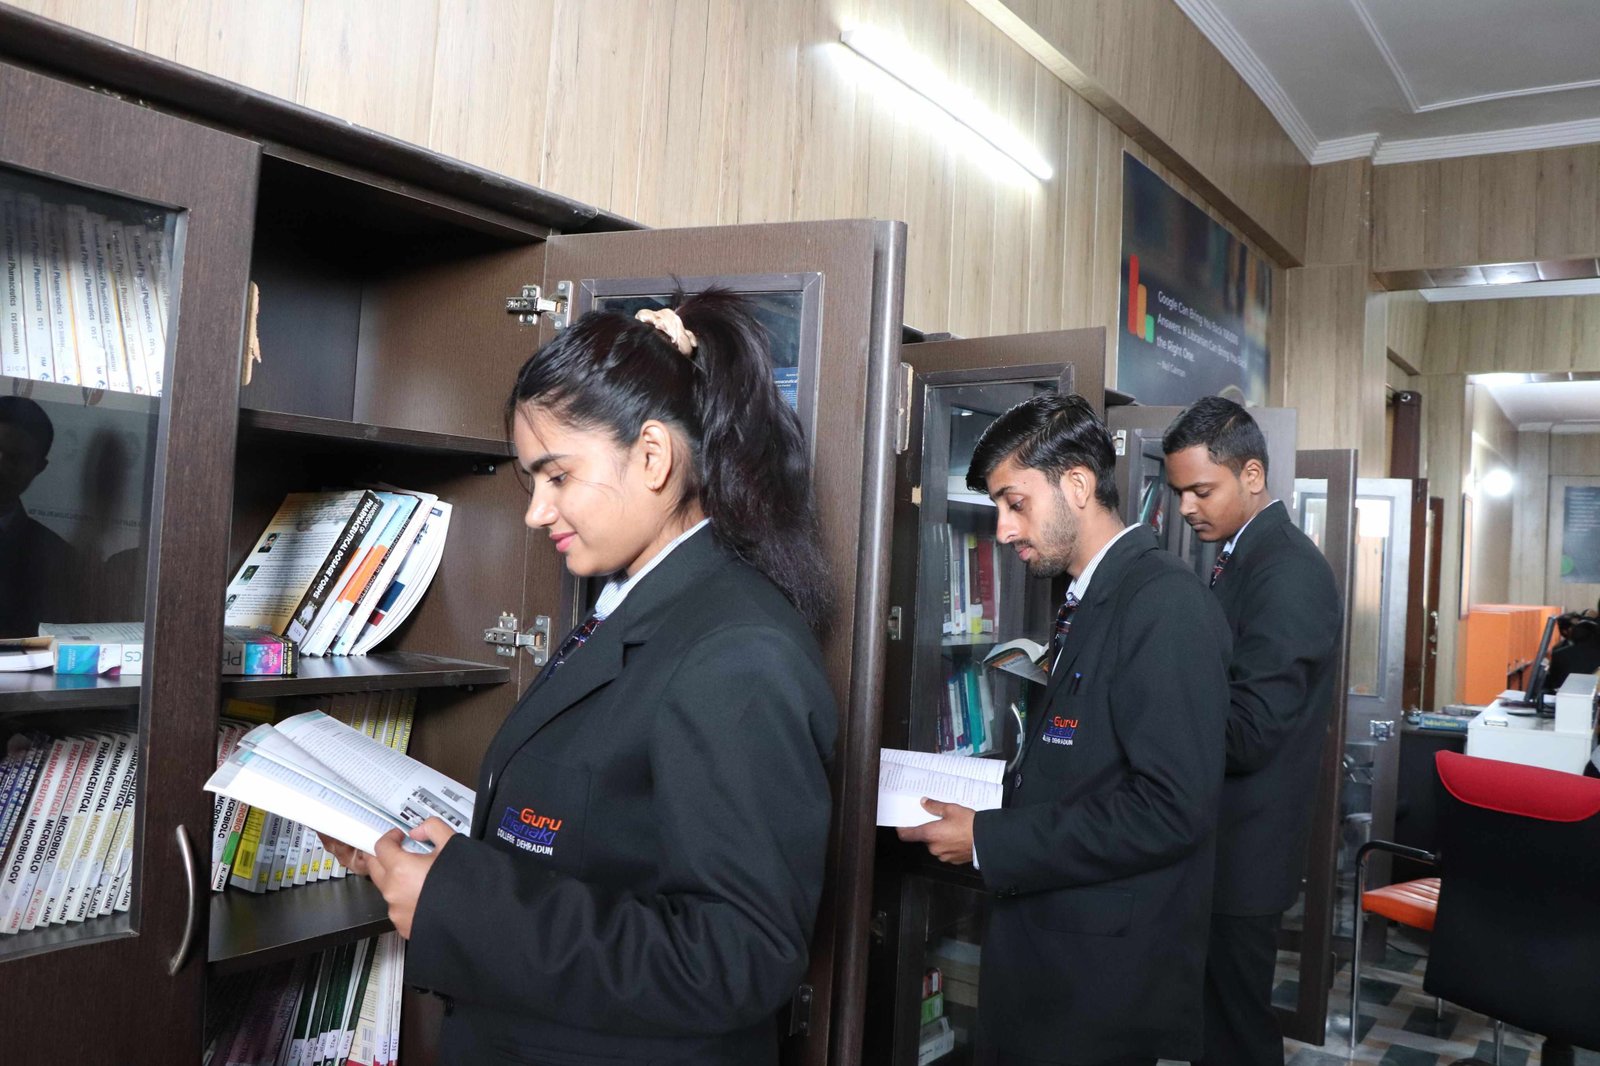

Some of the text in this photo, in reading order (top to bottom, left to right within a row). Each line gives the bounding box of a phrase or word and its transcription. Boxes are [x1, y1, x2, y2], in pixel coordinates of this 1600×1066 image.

[8, 261, 17, 306] Pharmaceutics
[33, 266, 44, 310] Pharmaceutics
[53, 270, 64, 314] Pharmaceutics
[84, 276, 97, 320] Pharmaceutics
[1158, 290, 1178, 311] Google
[1179, 302, 1189, 316] Can
[1190, 308, 1202, 327] Bring
[1203, 316, 1211, 330] You
[1156, 335, 1167, 350] the
[1168, 340, 1182, 357] Right
[359, 503, 379, 534] HANDBOOK OF
[312, 499, 374, 599] PHARMACEUTICAL DOSAGE FORMS
[1054, 716, 1078, 728] Guru
[6, 767, 19, 791] BOOK
[17, 765, 29, 788] BOOK
[22, 768, 36, 792] BOOK
[77, 741, 109, 814] PHARMACEUTICAL
[11, 789, 20, 801] OF
[18, 792, 26, 804] OF
[47, 741, 94, 863] PHARMACEUTICAL MICROBIOL
[79, 741, 126, 860] PHARMACEUTICAL MICROBIOL
[8, 743, 63, 884] PHARMACEUTICAL MICROBIOLOGY
[29, 743, 80, 874] PHARMACEUTICAL MICROBIOLO
[218, 797, 236, 839] ICROBIOLO
[233, 803, 248, 832] CROBIO
[521, 808, 562, 831] Guru
[2, 805, 22, 844] REMEDIAL
[96, 811, 119, 859] MICROBIOL
[516, 839, 553, 856] DEHRADUN
[67, 885, 75, 895] N.
[112, 875, 120, 884] N.
[216, 876, 224, 890] JAIN
[76, 900, 87, 918] JAIN
[89, 897, 99, 915] JAIN
[104, 892, 115, 909] JAIN
[121, 889, 131, 906] JAIN
[11, 911, 21, 929] JAIN
[25, 905, 37, 923] JAIN
[41, 905, 52, 922] JAIN
[58, 903, 69, 921] JAIN
